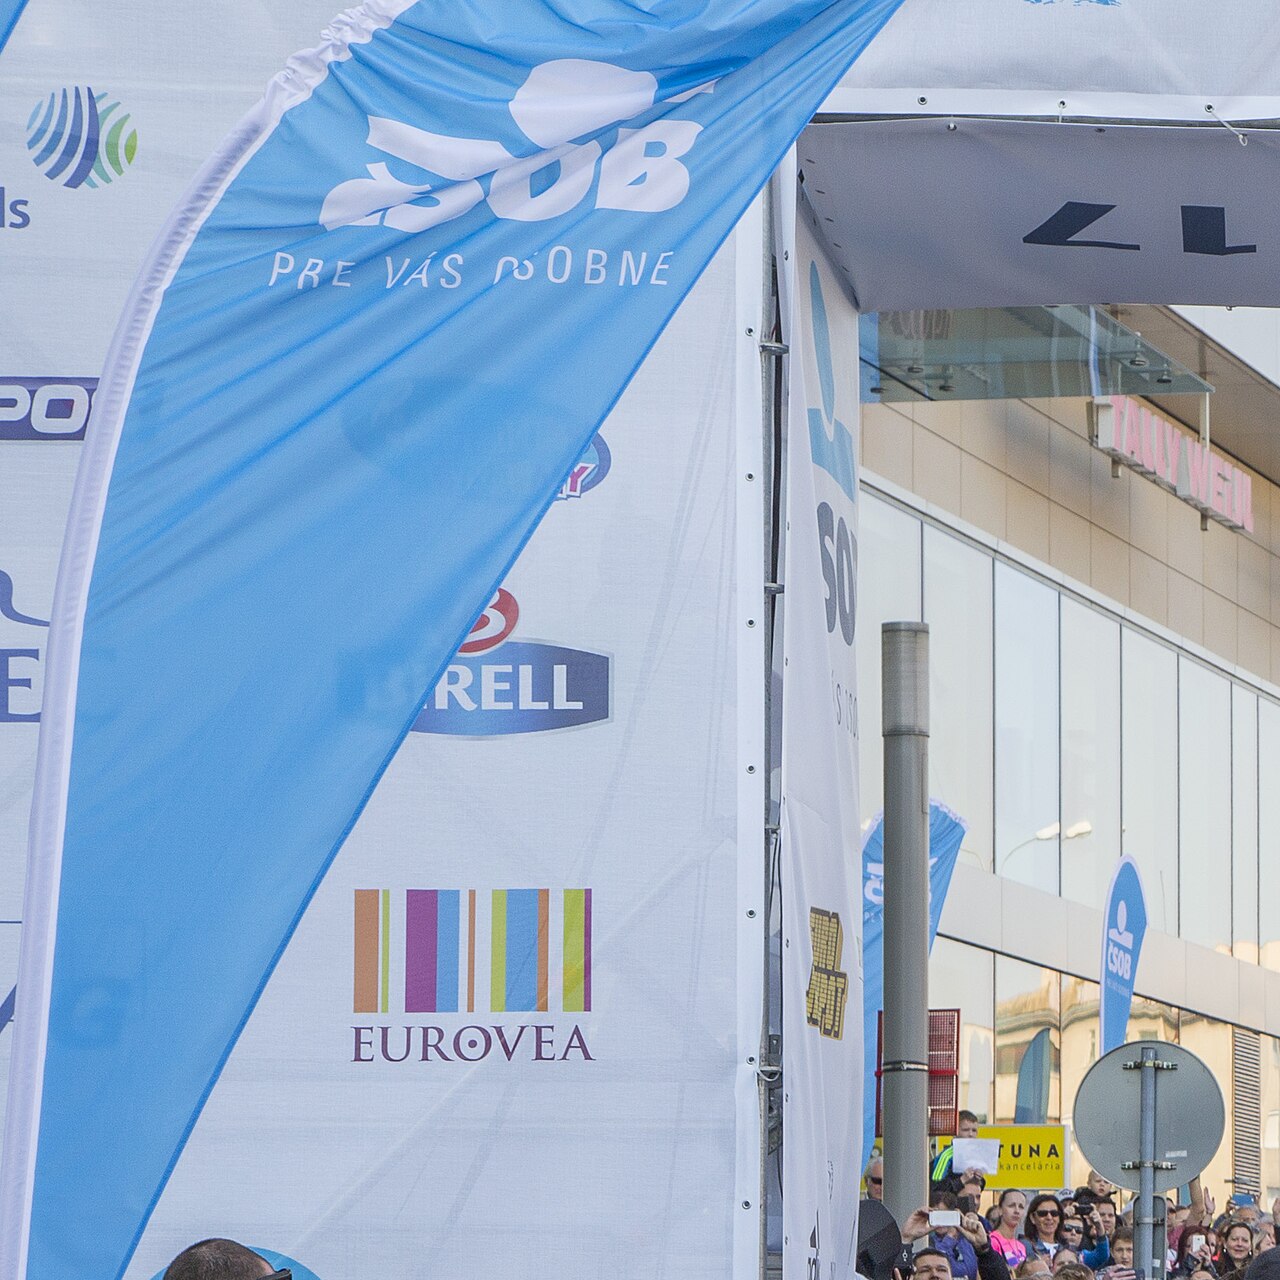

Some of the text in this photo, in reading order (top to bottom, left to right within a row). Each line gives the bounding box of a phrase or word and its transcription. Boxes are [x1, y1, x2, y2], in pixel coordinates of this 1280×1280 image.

[269, 252, 355, 289] PRE
[386, 251, 464, 289] VÁS
[1107, 944, 1132, 980] ČSOB
[350, 1024, 597, 1064] EUROVEA
